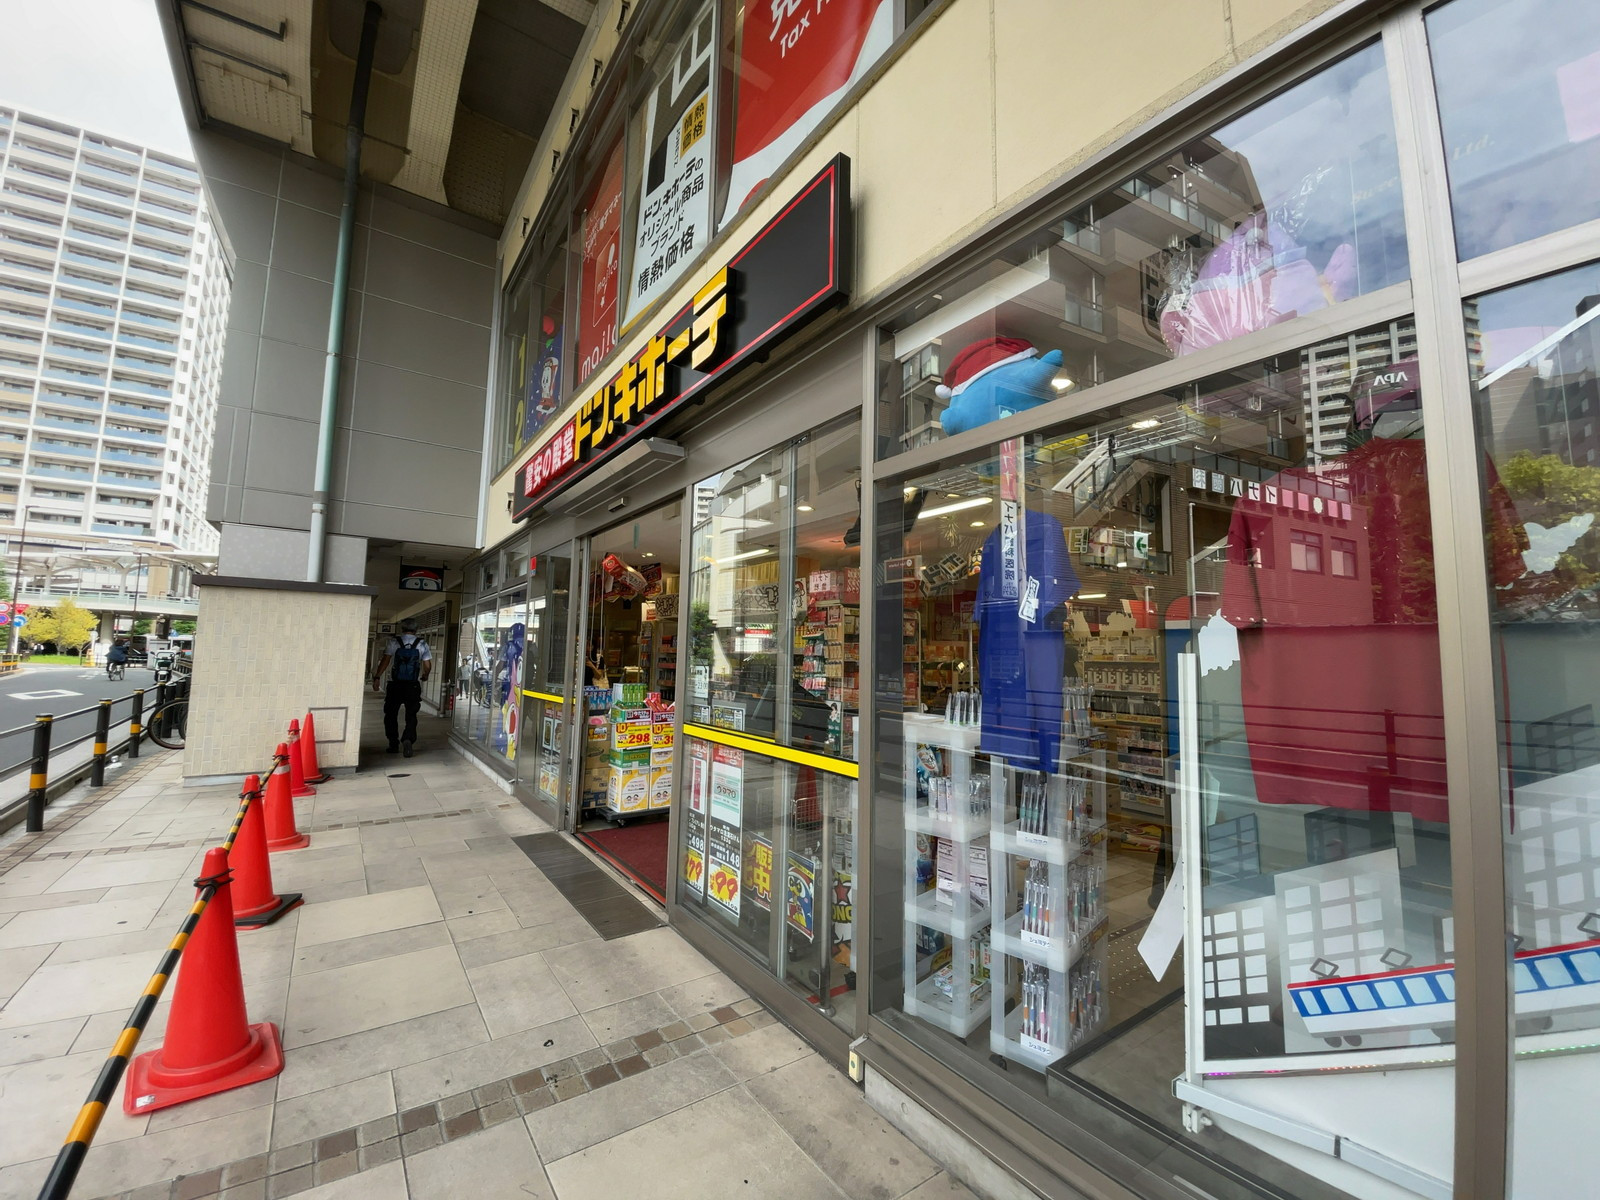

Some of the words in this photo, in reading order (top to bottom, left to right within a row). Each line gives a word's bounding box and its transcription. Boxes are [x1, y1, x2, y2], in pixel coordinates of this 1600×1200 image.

[780, 9, 811, 59] Tax
[639, 177, 705, 248] オリジナル商品
[650, 211, 686, 258] ブランド
[637, 223, 697, 299] 情熱価格
[524, 422, 575, 496] 驚安の殿堂
[628, 732, 651, 744] 298
[691, 835, 704, 852] 498
[725, 848, 740, 869] 148
[715, 870, 739, 902] 99
